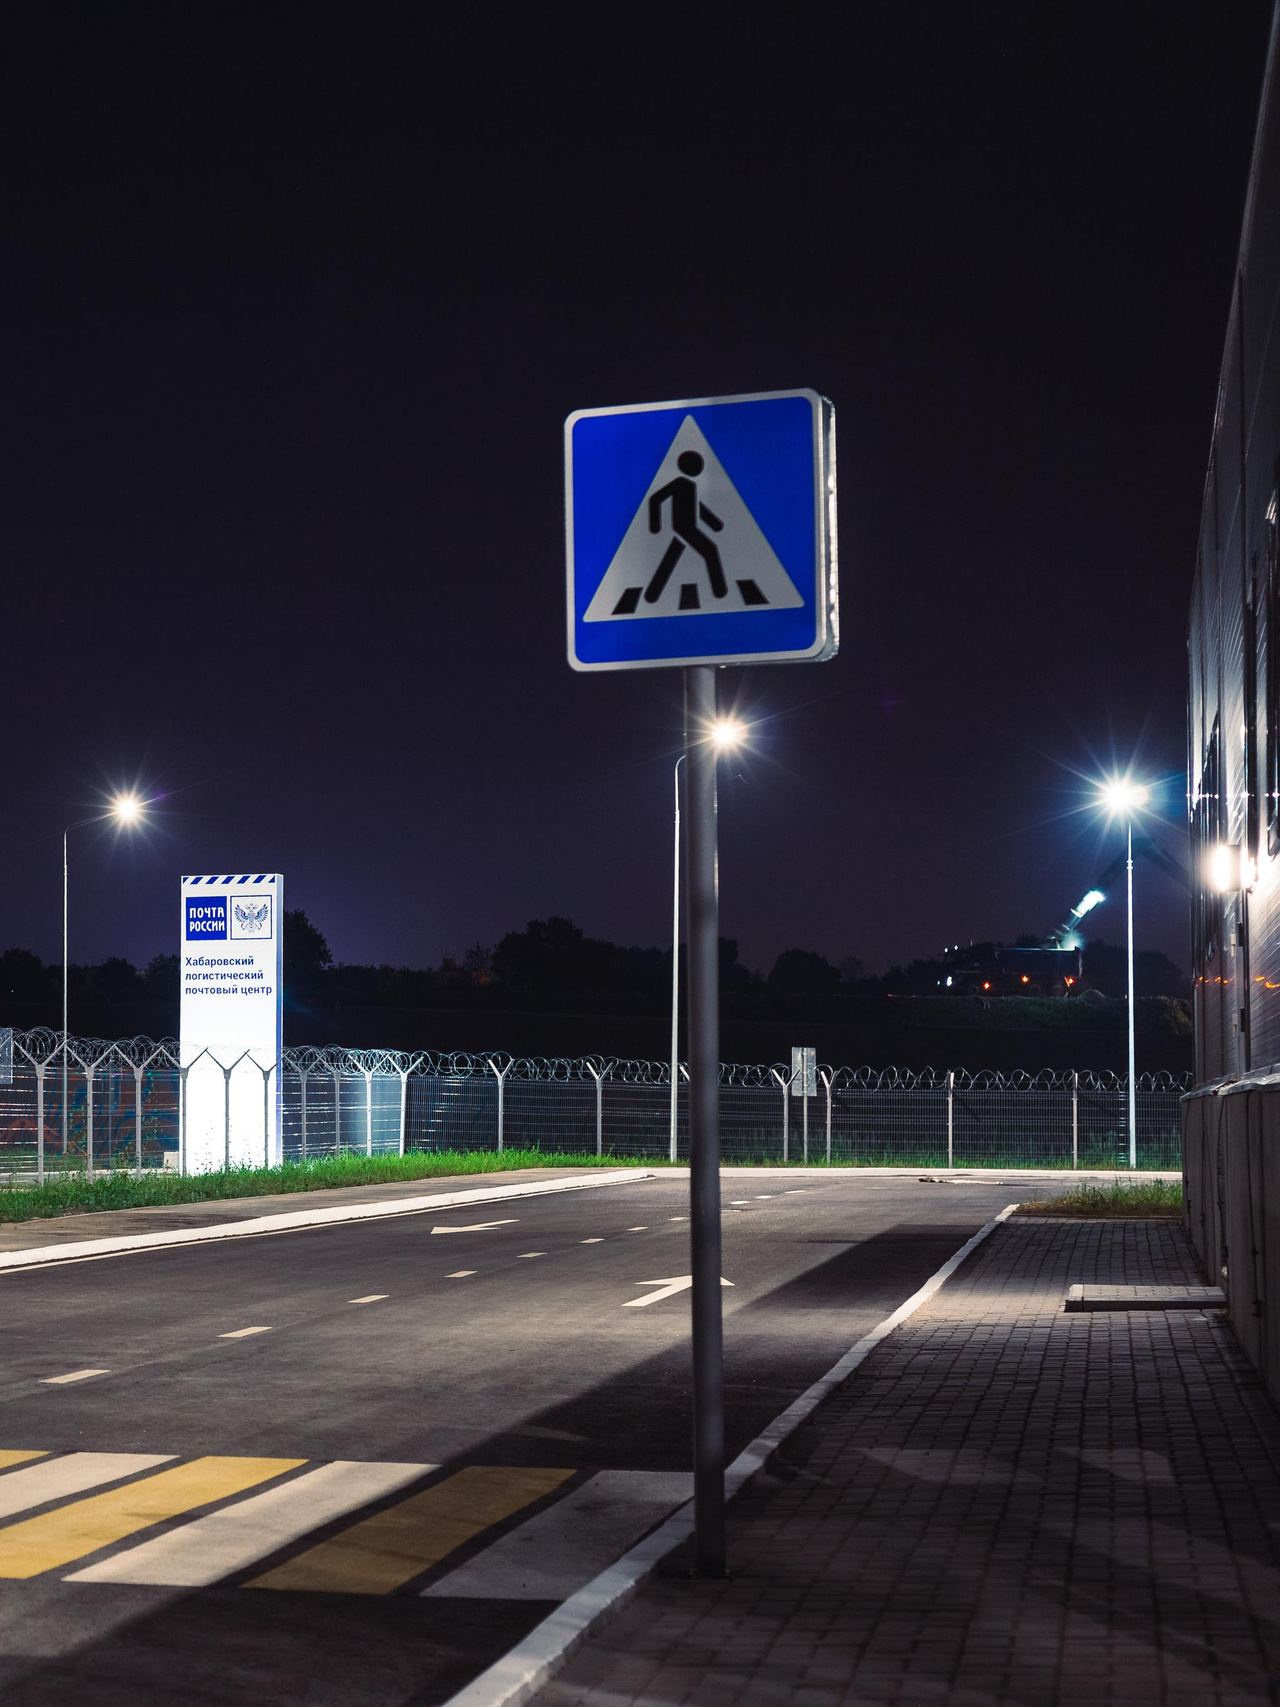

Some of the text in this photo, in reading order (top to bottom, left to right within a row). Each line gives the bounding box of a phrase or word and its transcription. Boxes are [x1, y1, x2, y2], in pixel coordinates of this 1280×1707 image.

[189, 907, 224, 918] ПОЧТА
[189, 921, 225, 932] РОССИИ
[185, 955, 254, 968] Хабаровский
[185, 969, 264, 980] логистический
[185, 985, 272, 996] почтовый центр
